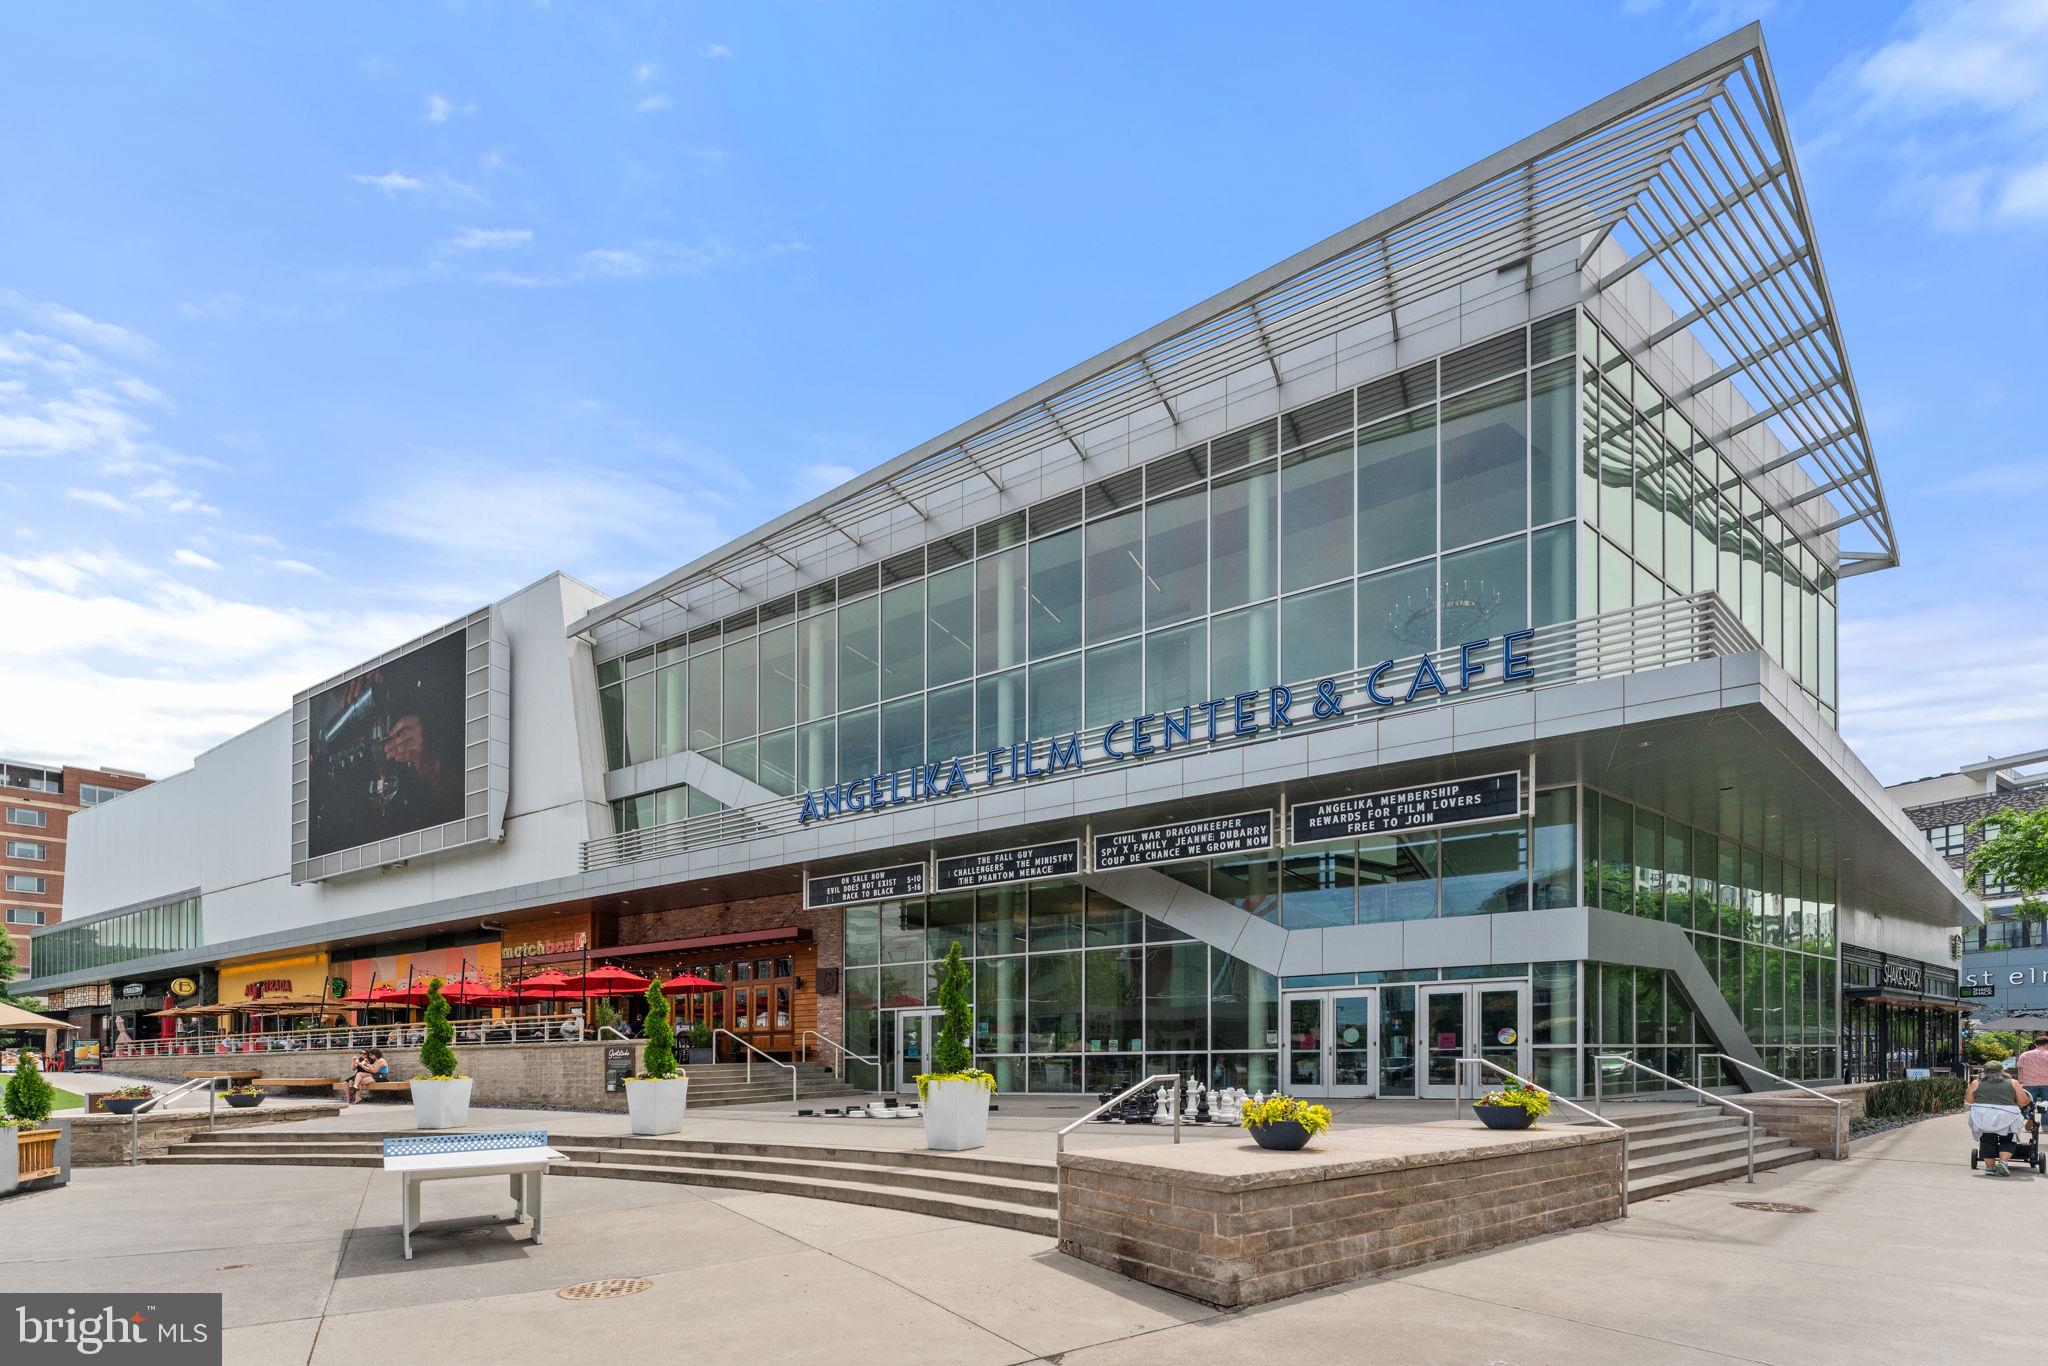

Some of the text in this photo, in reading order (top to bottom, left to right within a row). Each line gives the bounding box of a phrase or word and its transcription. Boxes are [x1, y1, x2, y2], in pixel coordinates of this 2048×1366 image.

[799, 627, 1536, 823] ANGELIKA FILM CENTER & CAFE
[1309, 794, 1482, 827] REWARDS FOR FILM LOVERS
[1318, 785, 1460, 815] ANGELIKA MEMBERSHIP
[1113, 818, 1242, 845] CIVIL WAR DRAGONKEEPER
[1348, 812, 1434, 833] FREE TO JOIN
[1101, 825, 1267, 857] SPY X FAMILY JEANNE DUBARRY
[1101, 835, 1268, 866] COUP DE CHANCE WE GROWN NOW
[954, 853, 1073, 877] CHALLENGERS THE MINISTRY
[978, 850, 1033, 865] THE FALL GUY
[827, 875, 921, 894] EVIL DOES NOT EXIST 5-10
[853, 874, 868, 883] SALE
[872, 872, 885, 880] NOW
[959, 865, 1052, 885] THE PHANTOM MENACE
[842, 884, 921, 900] BACK TO BLACK 5-16
[502, 940, 574, 959] matchbox
